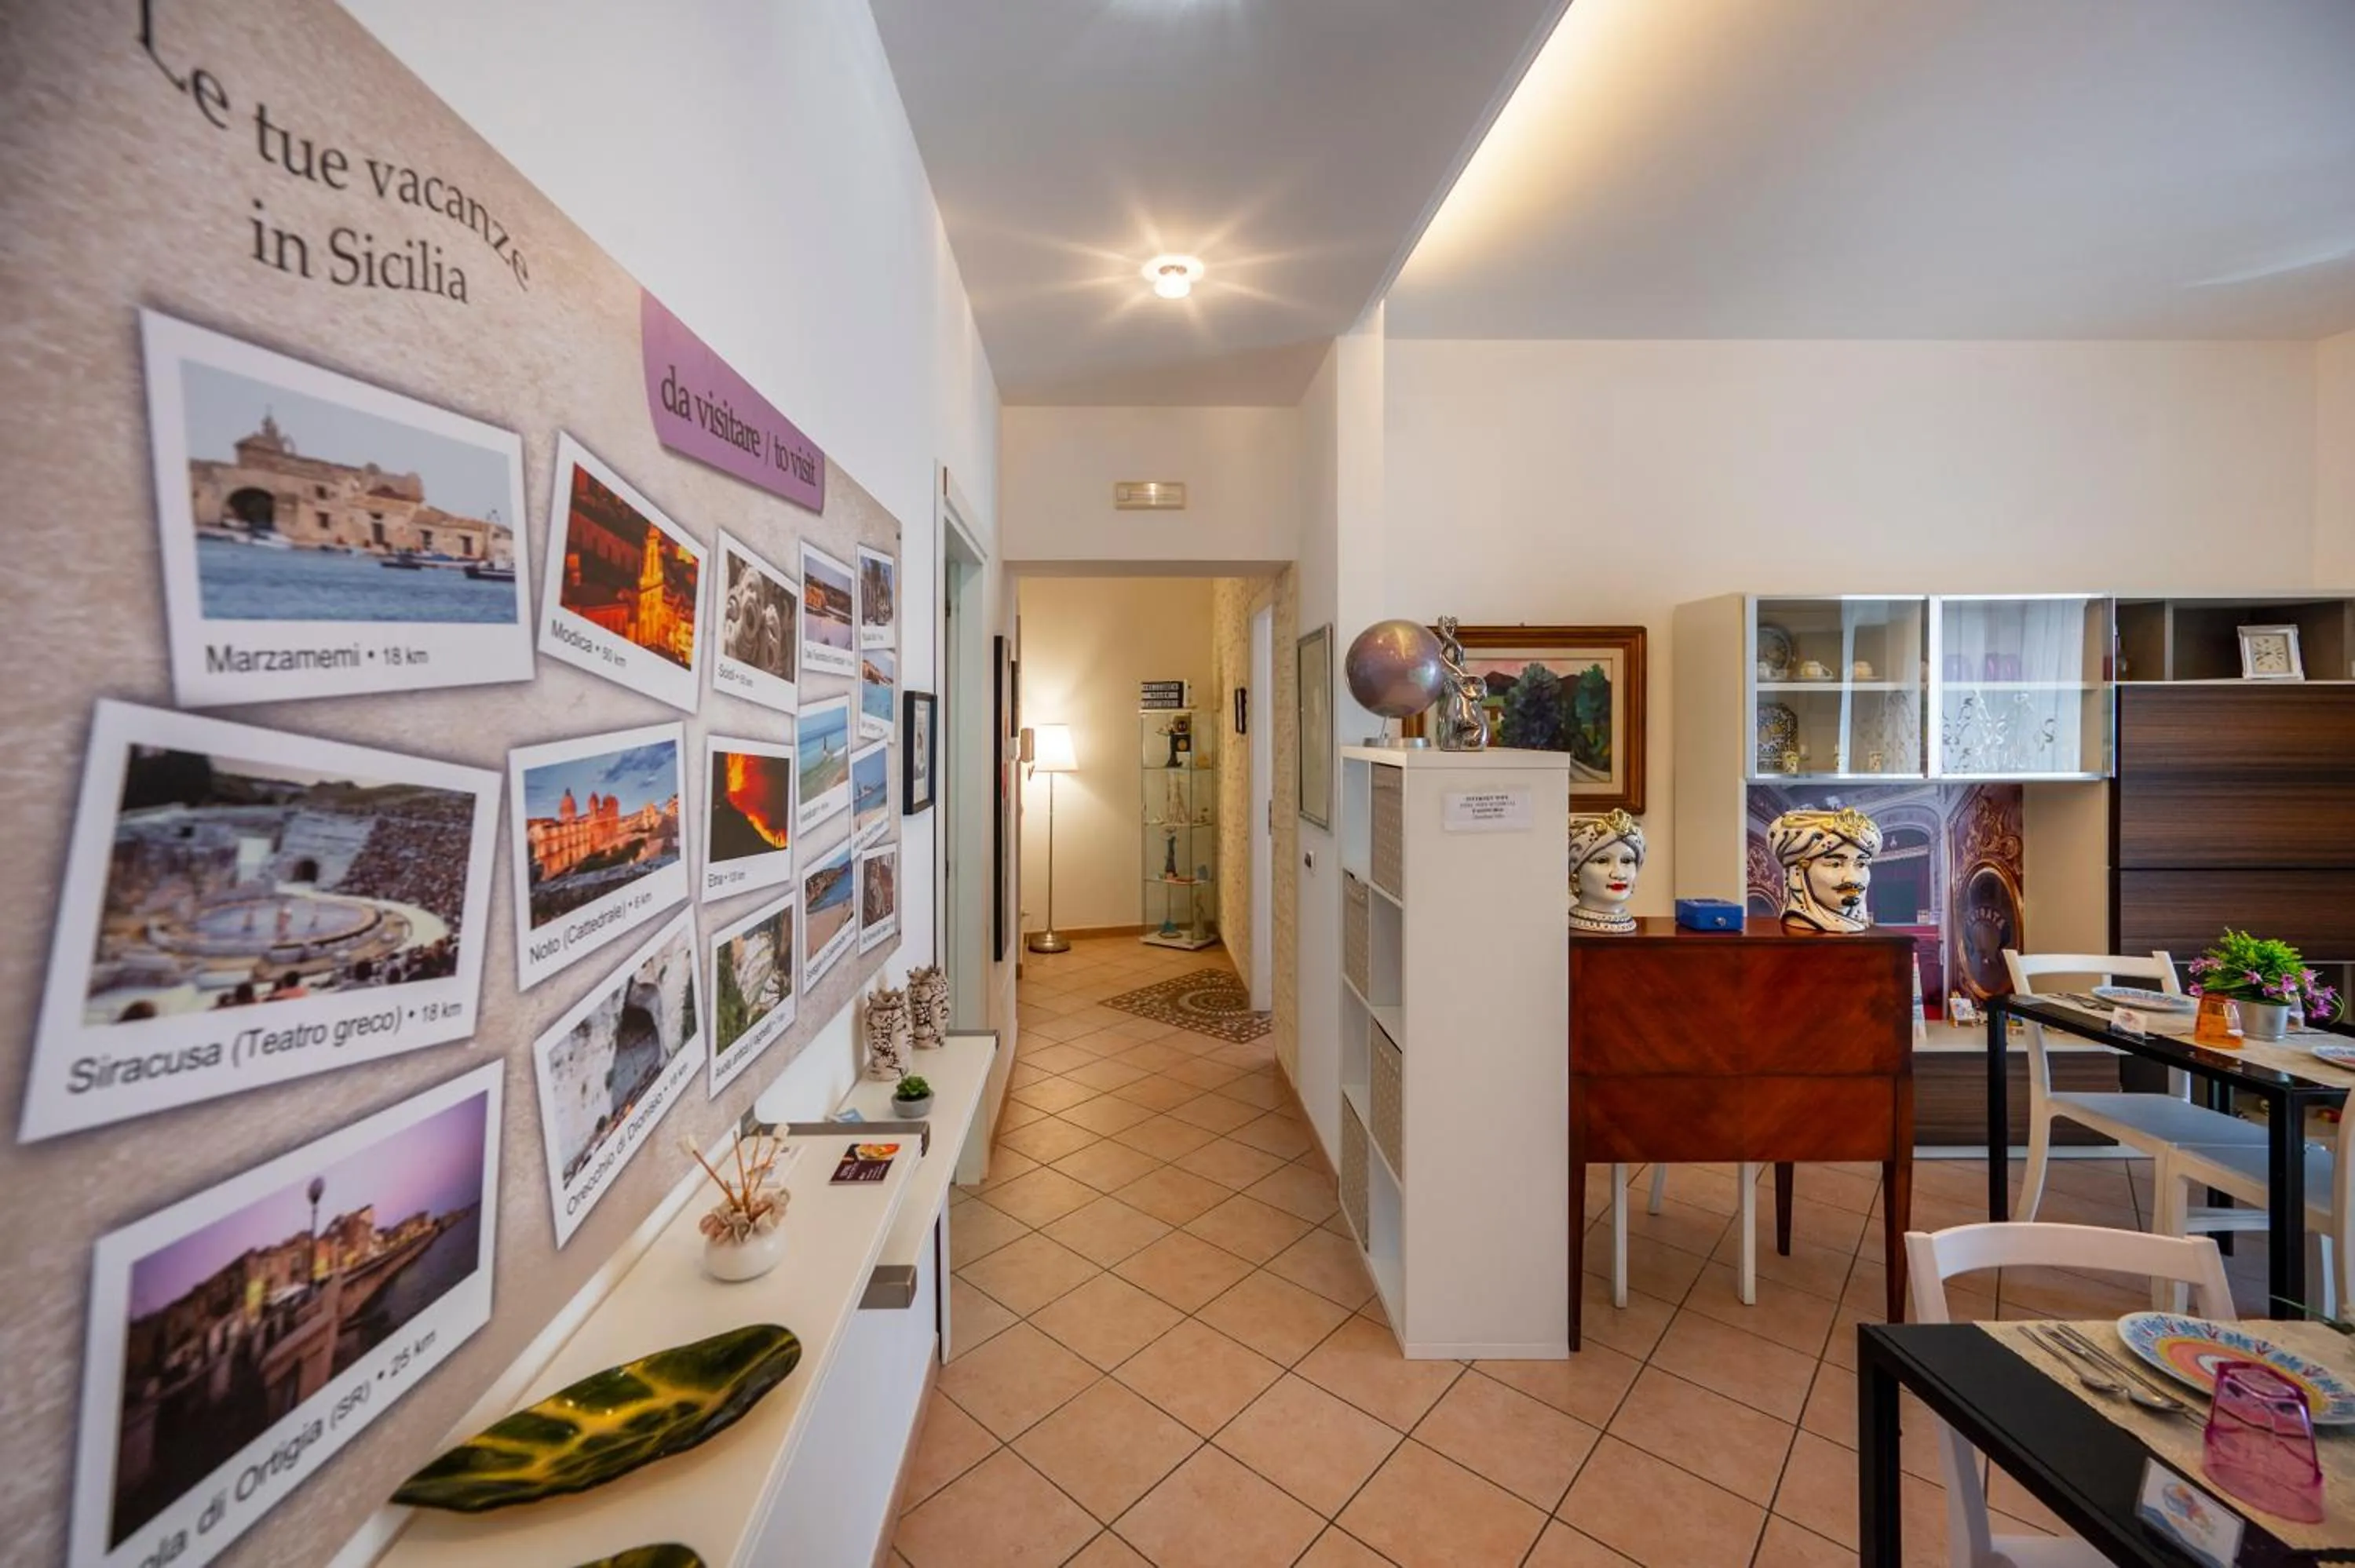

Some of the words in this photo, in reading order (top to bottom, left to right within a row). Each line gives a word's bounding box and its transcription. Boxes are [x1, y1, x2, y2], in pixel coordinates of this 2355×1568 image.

[134, 0, 229, 129] Le
[253, 102, 348, 189] tue
[365, 158, 531, 291] vacanze
[249, 198, 312, 279] in
[330, 227, 469, 304] Sicilia
[661, 364, 692, 422] da
[695, 390, 761, 458] visitare
[774, 434, 789, 472] to
[790, 445, 816, 487] visit
[205, 643, 361, 673] Marzamemi
[384, 647, 401, 666] 18
[406, 647, 429, 665] km
[550, 619, 593, 655] Modica
[530, 937, 560, 965] Noto
[67, 1041, 221, 1095] Siracusa
[231, 1019, 327, 1067] (Teatro
[334, 1005, 402, 1046] greco)
[421, 1004, 438, 1023] 18
[442, 1001, 462, 1019] km
[196, 1486, 226, 1536] di
[235, 1417, 324, 1502] Ortigia
[330, 1379, 371, 1431] (SR)
[414, 1329, 436, 1357] km
